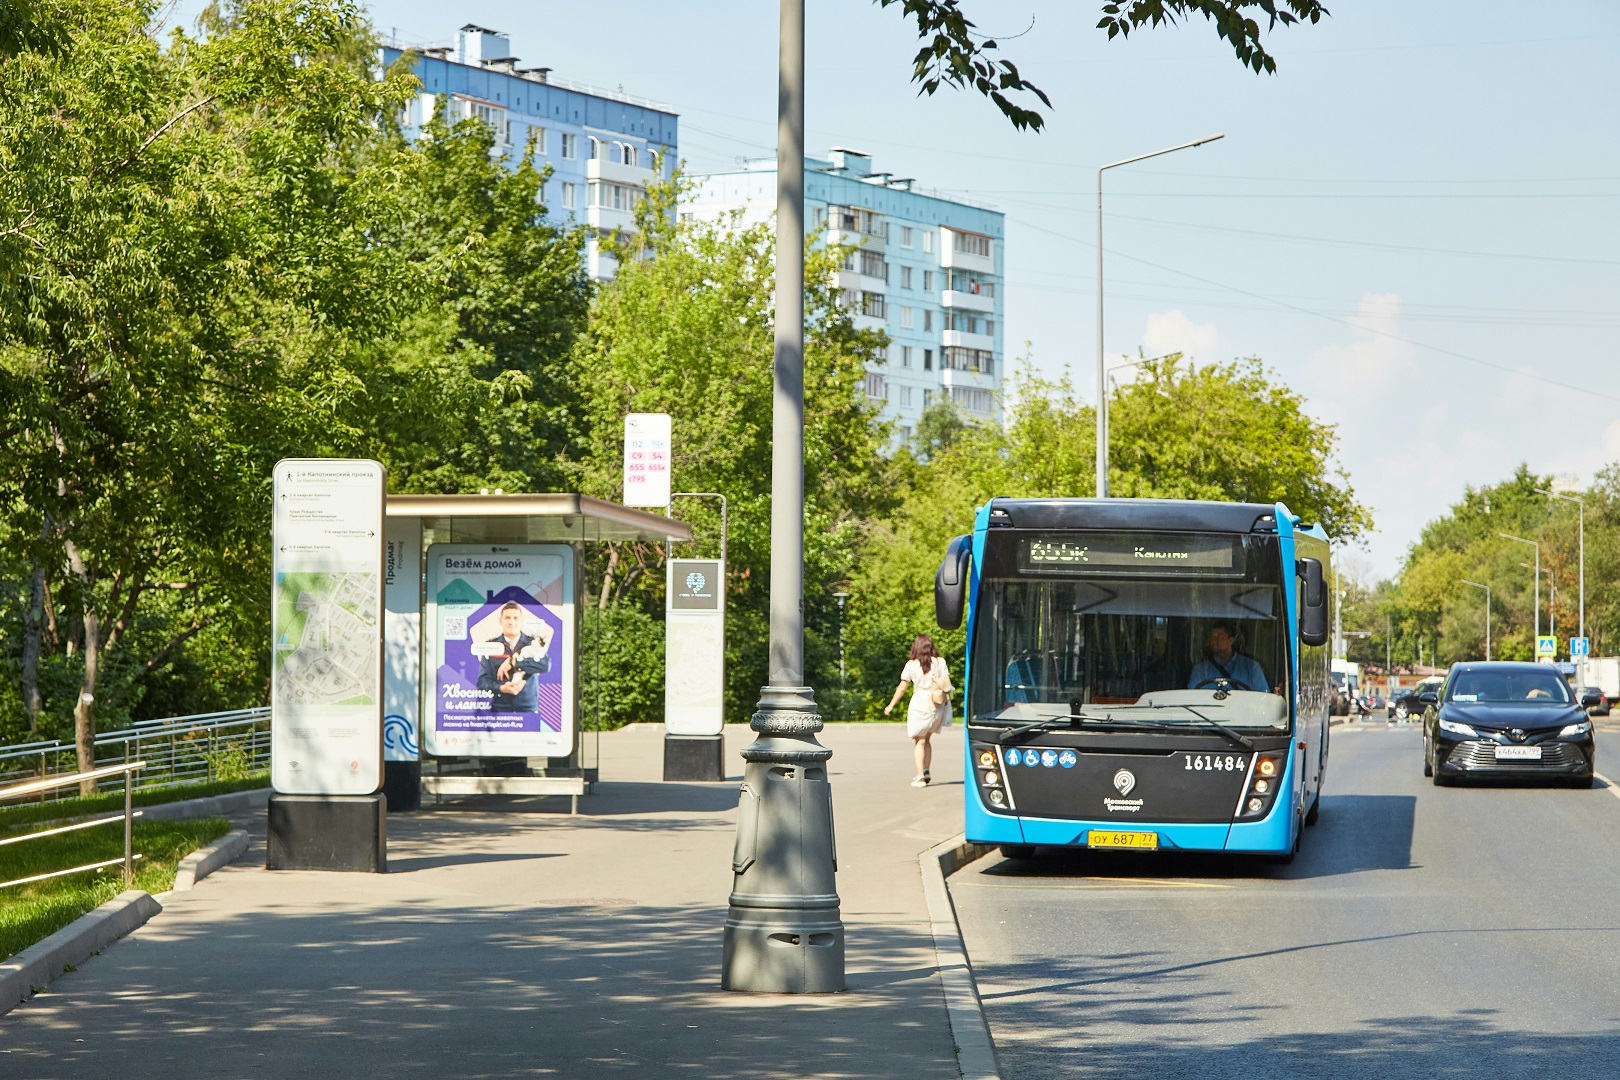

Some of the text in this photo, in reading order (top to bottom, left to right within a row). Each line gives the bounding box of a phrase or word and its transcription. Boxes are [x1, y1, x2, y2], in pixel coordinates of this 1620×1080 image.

[652, 452, 663, 460] 54
[629, 463, 645, 471] 655
[386, 540, 395, 586] Продмаг
[445, 558, 522, 570] Везём домой
[442, 683, 495, 699] Хвосты
[445, 701, 492, 710] и лапки
[1184, 755, 1246, 771] 161484
[1104, 797, 1144, 806] Московский
[1106, 803, 1141, 812] Транспорт
[1093, 833, 1153, 845] ОУ 687 77
